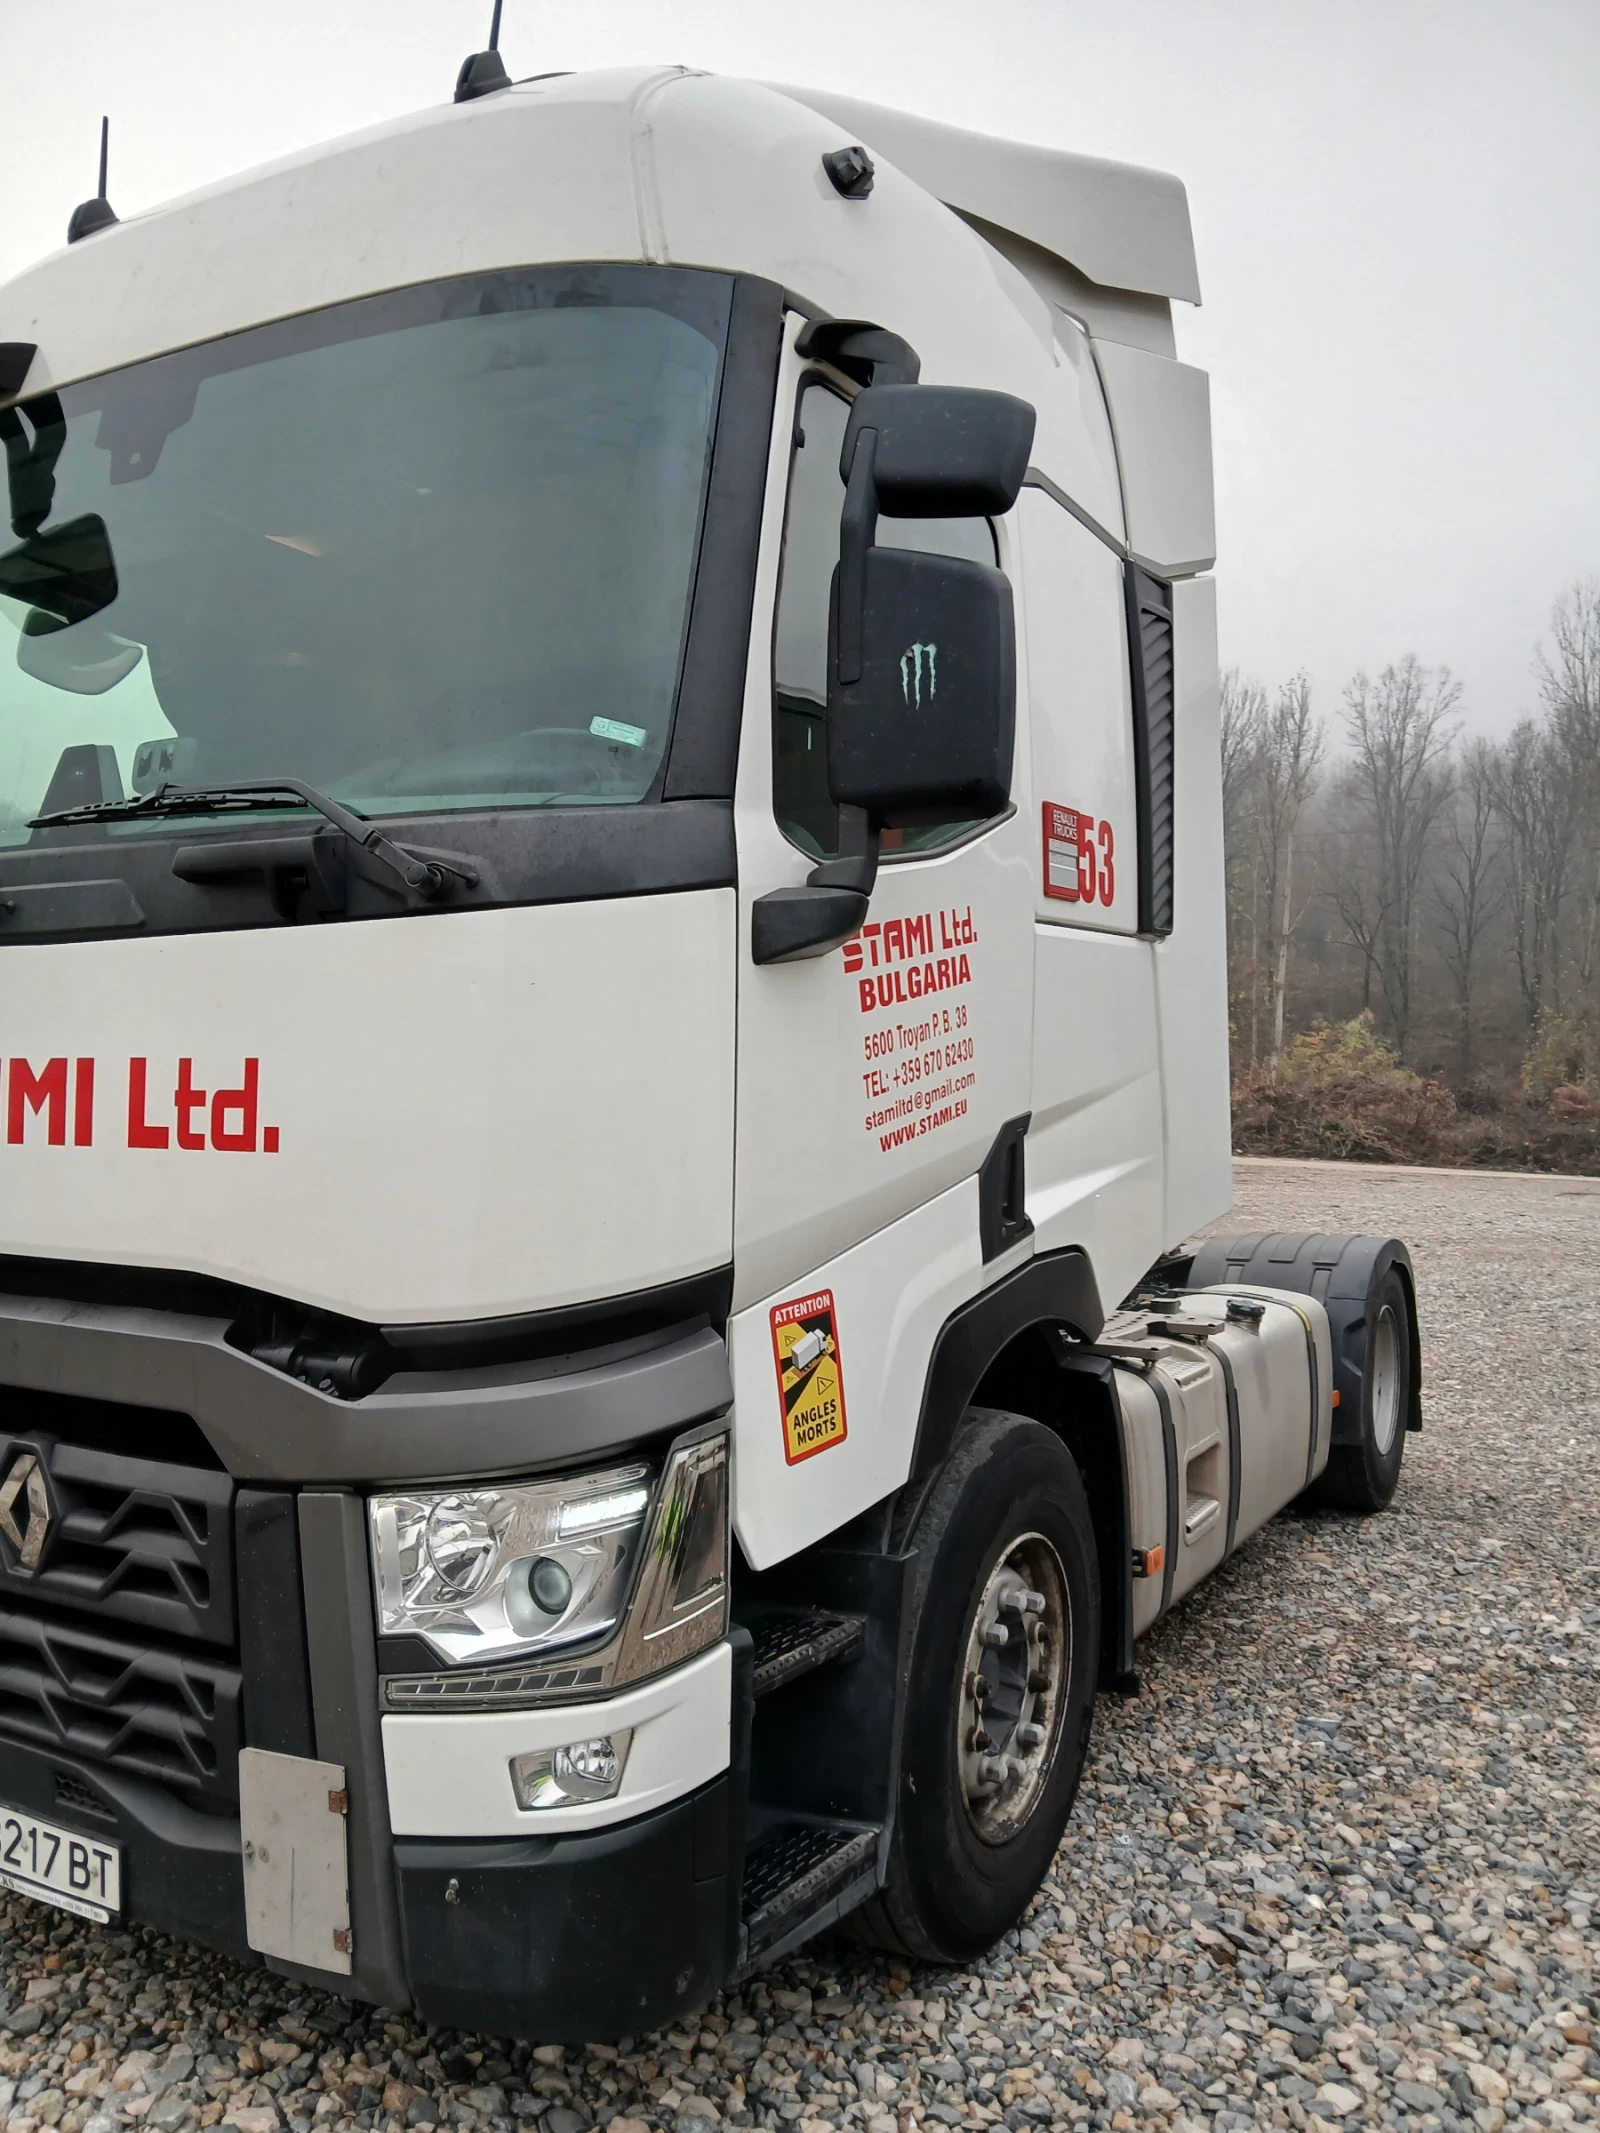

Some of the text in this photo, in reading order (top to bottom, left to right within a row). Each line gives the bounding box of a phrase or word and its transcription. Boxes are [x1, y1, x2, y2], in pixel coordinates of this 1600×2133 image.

[1053, 809, 1078, 827] RENAULT
[1053, 822, 1078, 840] TRUCKS
[1079, 814, 1114, 907] 53
[842, 905, 978, 974] STAMI Ltd.
[859, 953, 972, 1013] BULGARIA
[864, 1004, 968, 1061] 5600 Troyan P. B. 38
[863, 1037, 974, 1100] TEL: +359 670 62430
[0, 1057, 280, 1153] MI Ltd.
[865, 1072, 976, 1131] stamiltd@gmail.com
[879, 1099, 968, 1153] WWW.STAMI.EU
[774, 1294, 831, 1325] ATTENTION
[793, 1398, 837, 1431] ANGLES
[797, 1416, 836, 1447] MORTS
[0, 1818, 113, 1898] 217 BT
